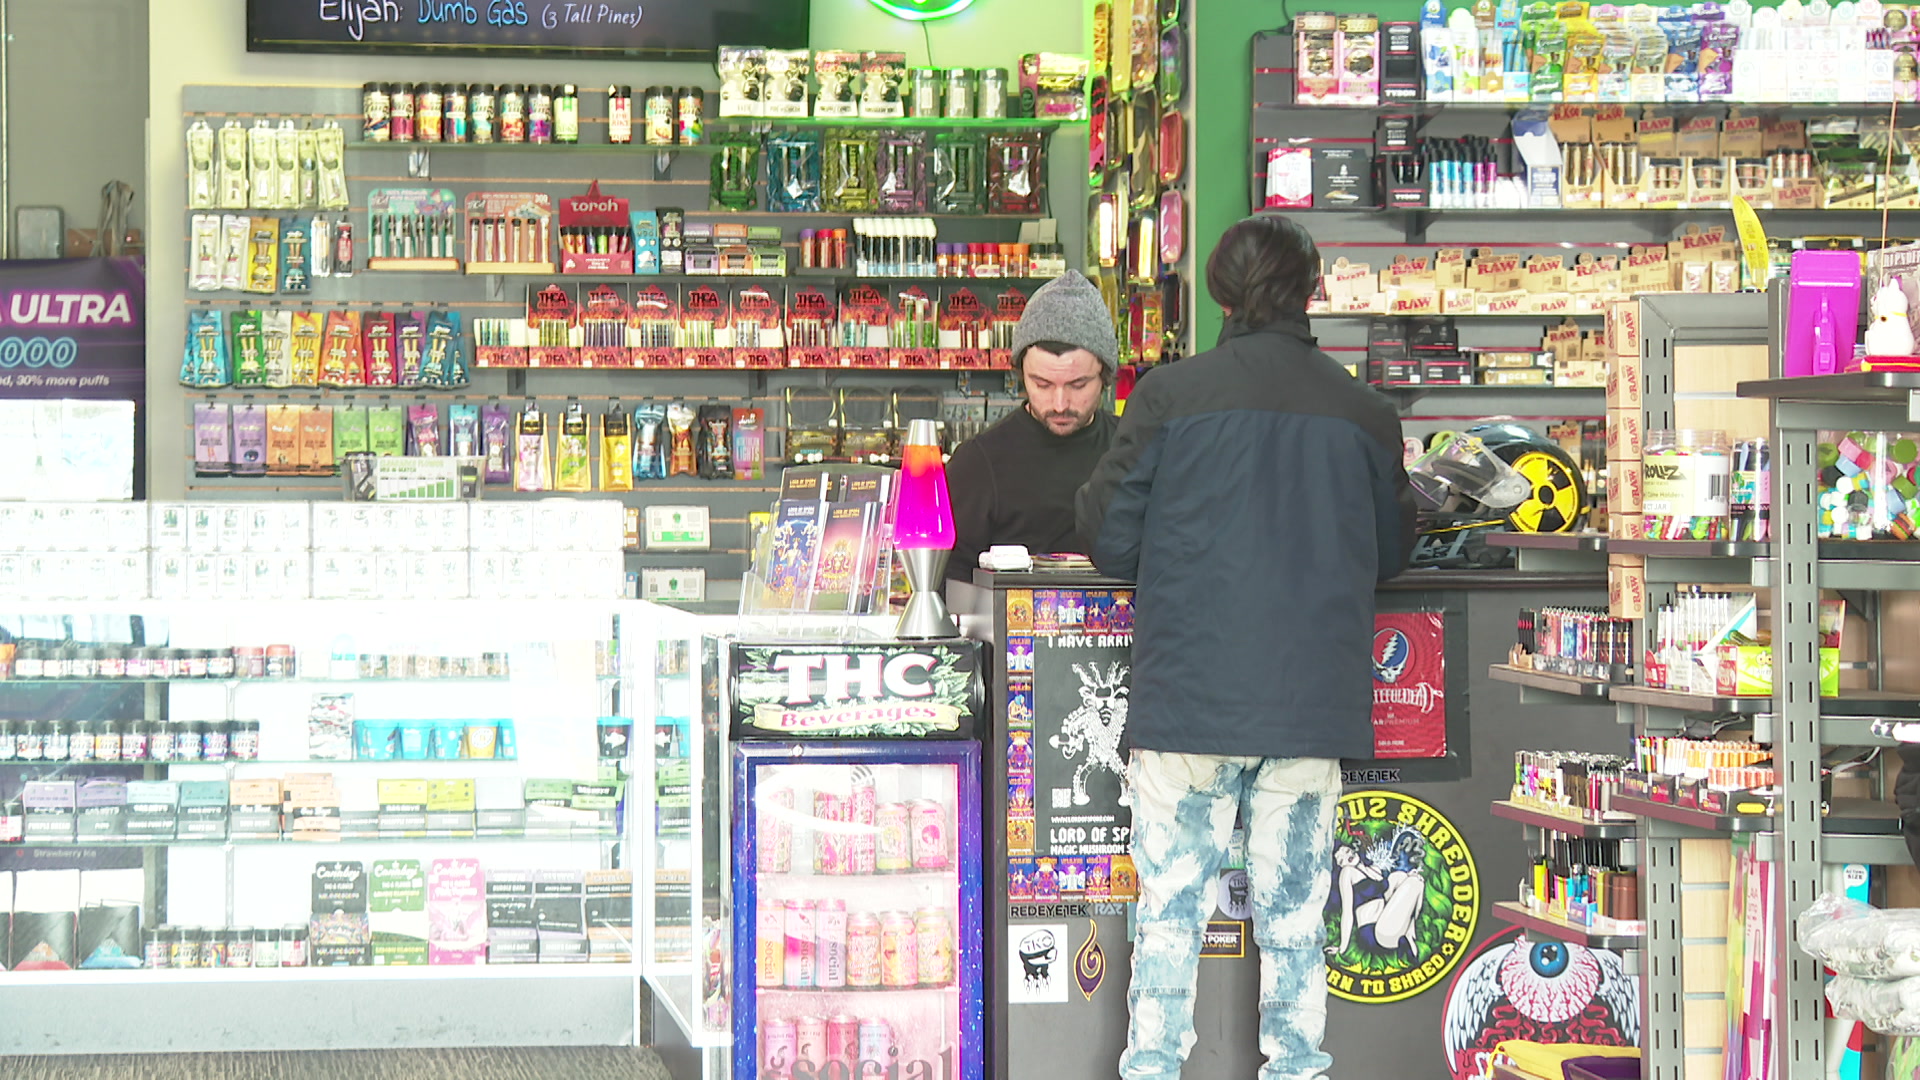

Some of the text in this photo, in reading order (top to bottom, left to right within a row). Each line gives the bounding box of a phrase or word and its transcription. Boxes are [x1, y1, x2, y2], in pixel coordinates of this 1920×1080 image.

[319, 0, 643, 41] Elijah: Dumb Gas (3 Tall Pines)
[1384, 89, 1416, 97] TYSON
[1640, 118, 1672, 130] RAW
[1681, 117, 1713, 130] RAW
[1726, 118, 1757, 130] RAW
[1778, 186, 1812, 200] RAW
[570, 200, 619, 212] torch
[1683, 232, 1722, 249] RAW
[1628, 252, 1665, 267] RAW
[1477, 260, 1516, 275] RAW
[1529, 260, 1561, 274] RAW
[539, 292, 565, 302] THCA
[690, 292, 717, 303] THCA
[797, 293, 824, 305] THCA
[851, 290, 879, 301] THCA
[951, 293, 977, 305] THCA
[10, 294, 131, 324] ULTRA
[1350, 302, 1370, 311] RAW
[1398, 297, 1431, 311] RAW
[1489, 299, 1519, 312] RAW
[1541, 300, 1568, 312] RAW
[1625, 311, 1637, 339] RAW
[1550, 330, 1577, 342] RAW
[749, 354, 768, 365] THCA
[804, 354, 823, 365] THCA
[855, 355, 873, 365] THCA
[904, 355, 924, 365] THCA
[955, 355, 974, 365] THCA
[16, 375, 43, 386] 30%
[45, 378, 77, 386] more
[79, 375, 110, 388] puffs
[1626, 365, 1639, 393] RAW
[1627, 417, 1639, 446] RAW
[1628, 470, 1640, 495] RAW
[1630, 575, 1642, 604] RAW
[1058, 636, 1093, 648] HAVE
[773, 653, 938, 706] THC
[780, 705, 937, 728] Beverages
[1050, 827, 1086, 844] LORD
[1091, 827, 1108, 843] OF
[33, 848, 82, 859] Strawberry
[1050, 844, 1077, 855] MAGIC
[1079, 844, 1124, 855] MUSHROOM
[1397, 802, 1474, 945] SHREDDER
[1208, 935, 1237, 944] POKER
[764, 940, 774, 980] social
[801, 940, 810, 981] social
[828, 941, 839, 981] social
[1325, 953, 1446, 995] RN TO SHRED
